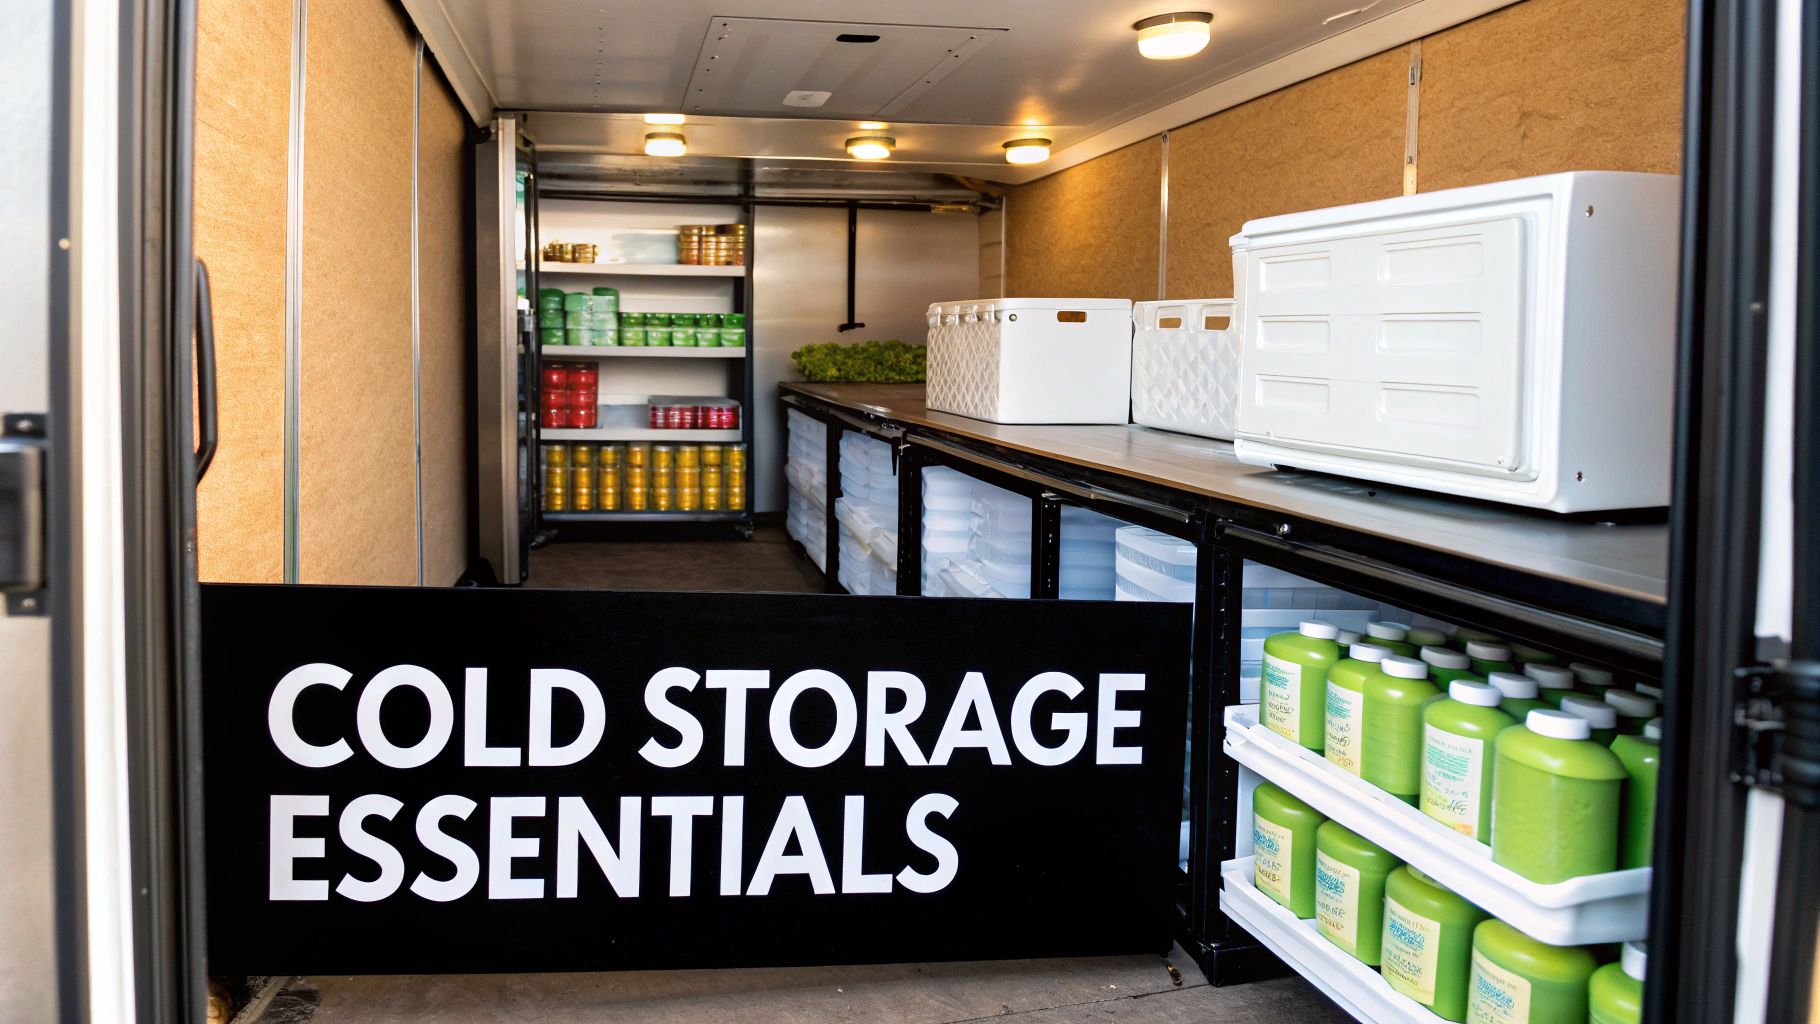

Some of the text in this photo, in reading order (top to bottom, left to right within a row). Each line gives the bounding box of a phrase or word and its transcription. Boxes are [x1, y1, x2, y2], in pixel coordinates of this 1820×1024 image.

[267, 663, 606, 769] COLD
[637, 667, 1146, 769] STORAGE
[268, 792, 960, 904] ESSENTIALS
